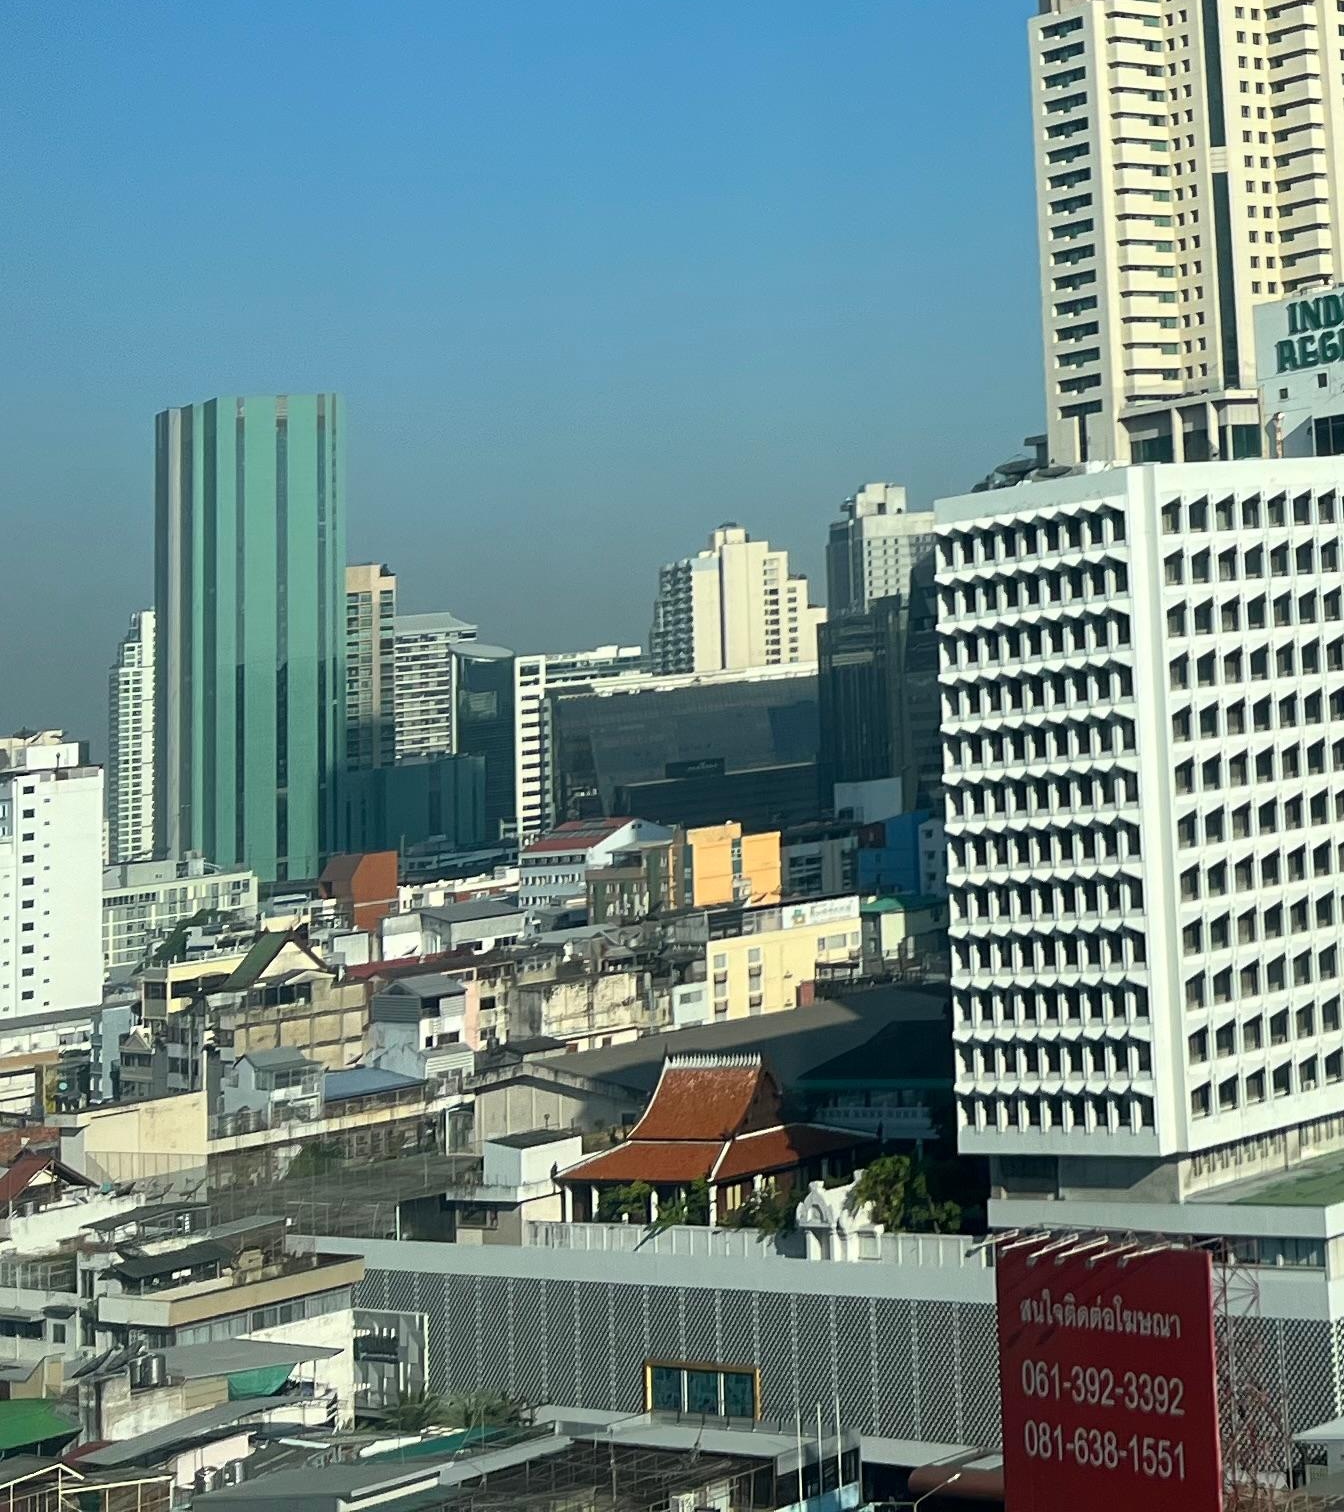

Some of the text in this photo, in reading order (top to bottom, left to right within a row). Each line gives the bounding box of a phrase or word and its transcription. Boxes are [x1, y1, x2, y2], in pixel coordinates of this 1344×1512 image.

[1020, 1288, 1181, 1339] สนใจติดต่อโฆษณา
[1022, 1359, 1185, 1415] 061-392-3392
[1024, 1419, 1185, 1482] 081-638-1551
